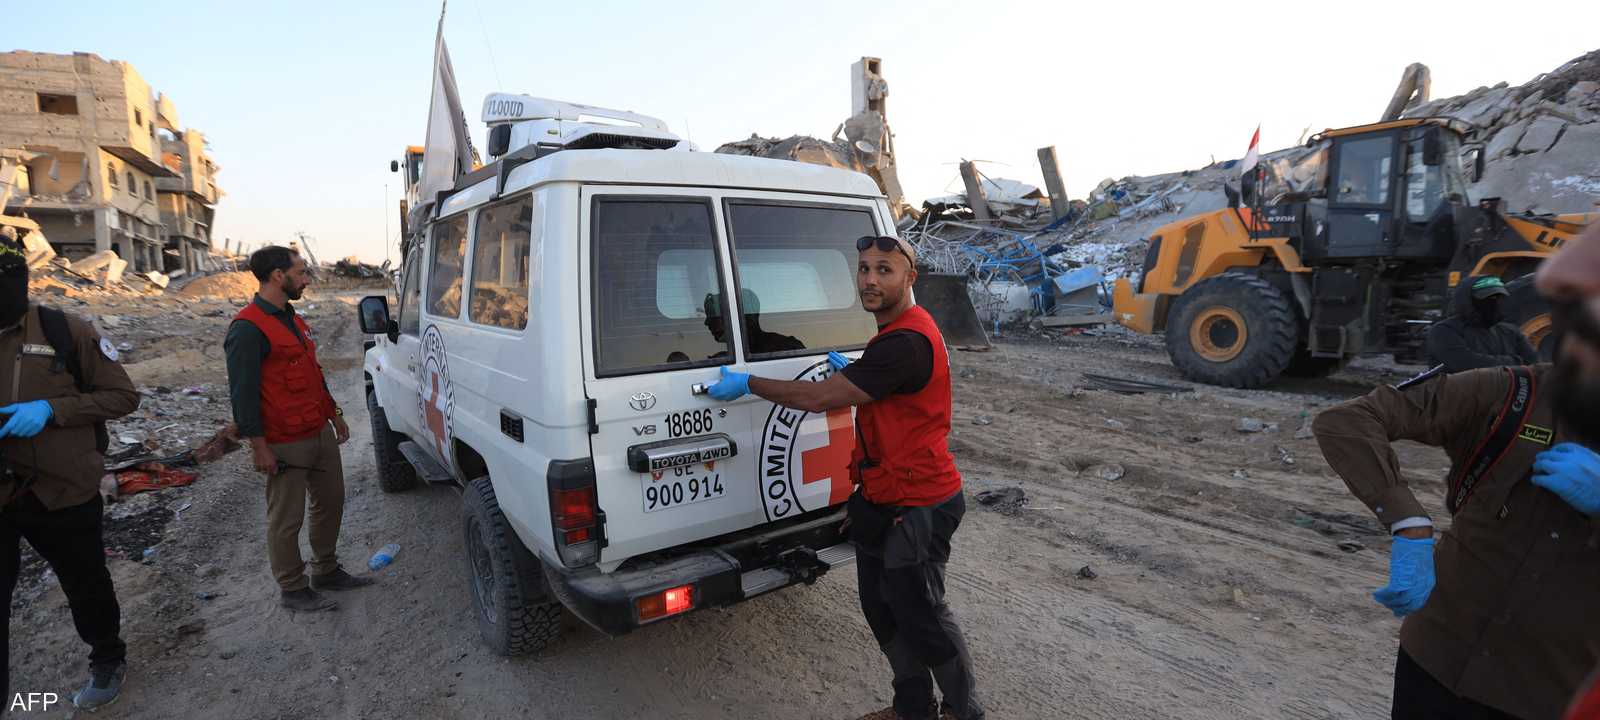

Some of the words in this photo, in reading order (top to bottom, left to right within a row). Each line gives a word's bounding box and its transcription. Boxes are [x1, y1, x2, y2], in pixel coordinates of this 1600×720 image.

[632, 424, 656, 436] V8
[665, 408, 713, 438] 18686
[654, 454, 698, 467] TOYOTA
[703, 447, 729, 460] 4WD
[646, 482, 684, 510] 900
[688, 474, 724, 501] 914
